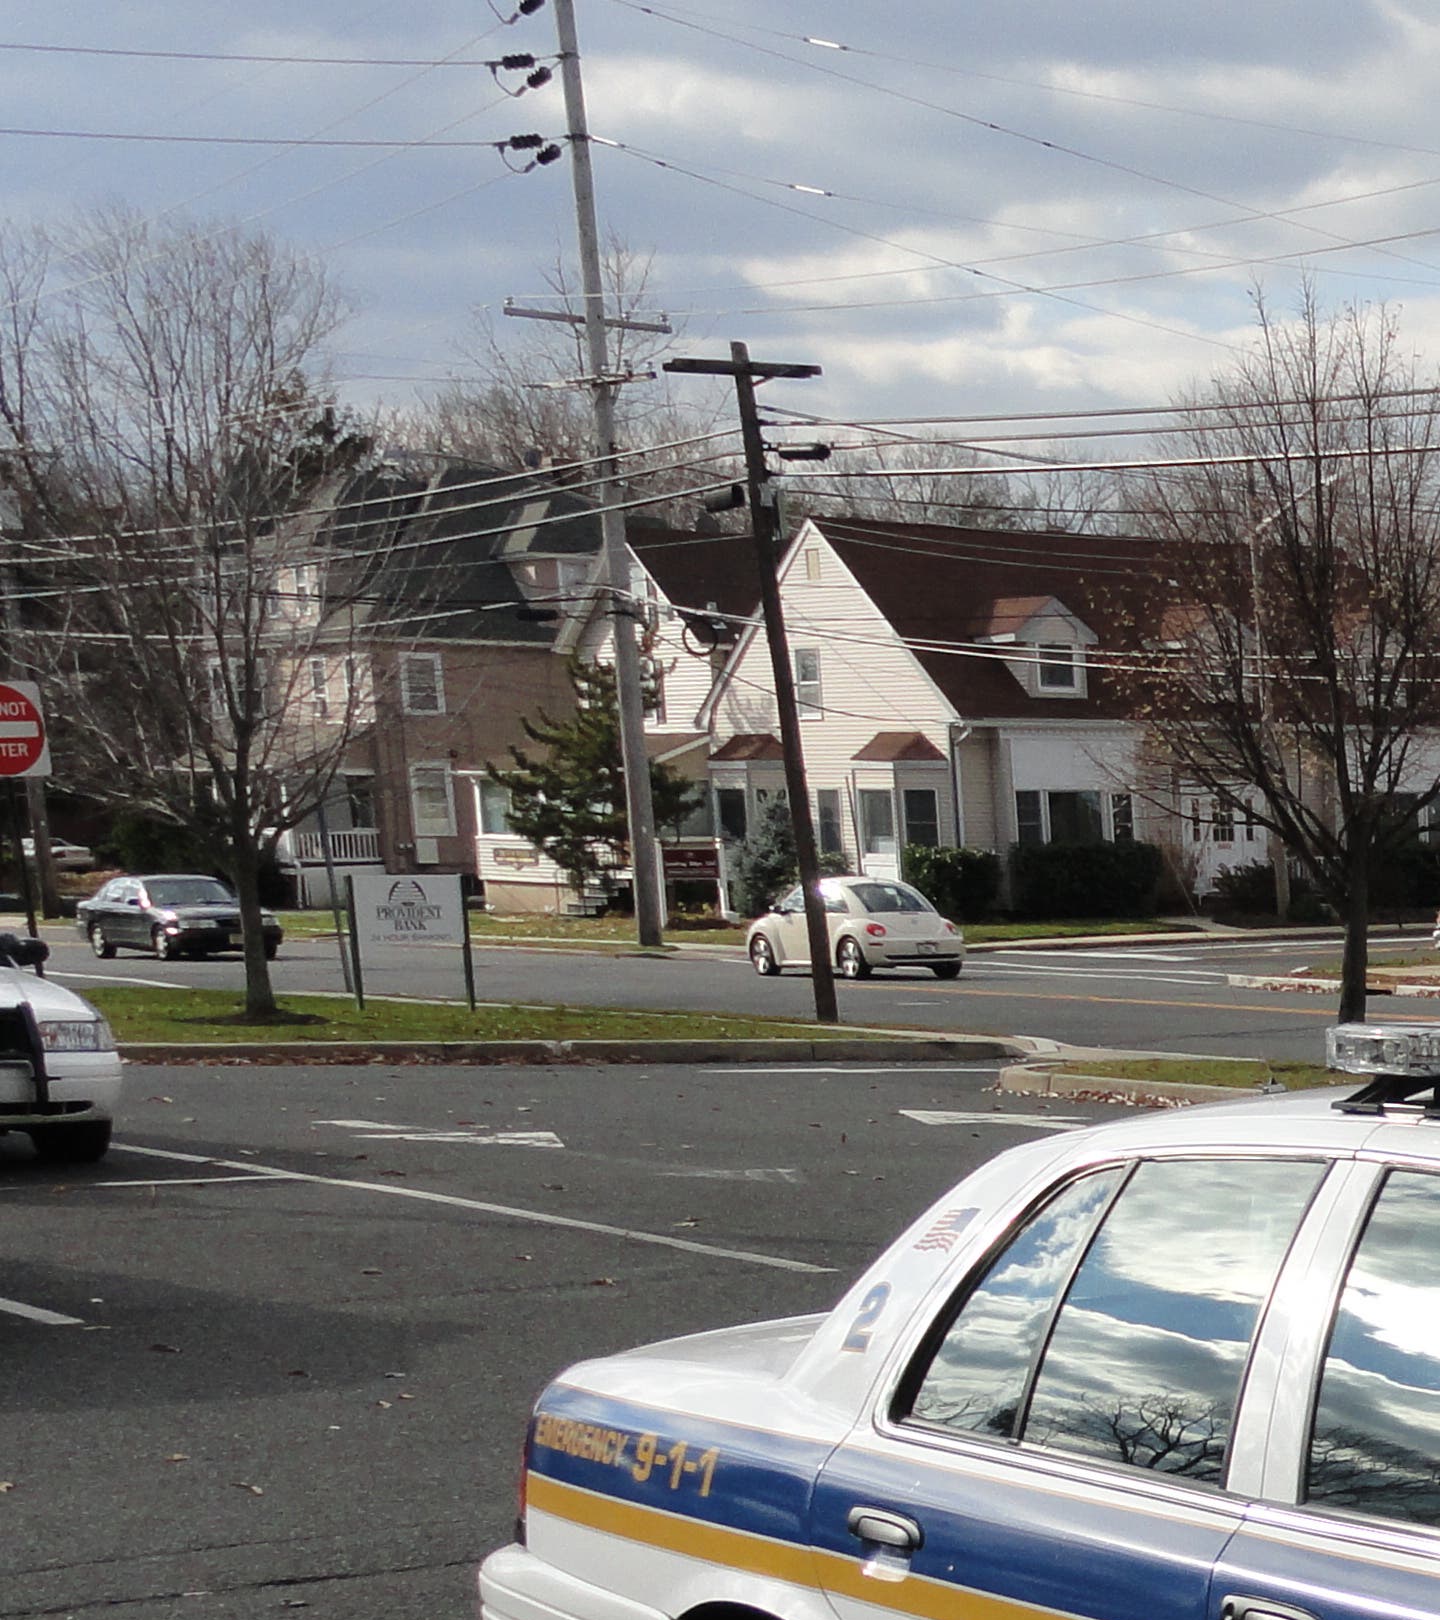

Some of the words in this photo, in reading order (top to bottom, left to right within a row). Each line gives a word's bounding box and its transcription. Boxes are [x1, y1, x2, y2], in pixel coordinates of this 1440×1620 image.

[0, 702, 27, 716] NOT
[0, 743, 29, 757] TER
[376, 905, 442, 920] PROVIDENT
[394, 920, 428, 931] BANK
[840, 1281, 892, 1354] 2
[631, 1431, 721, 1498] 9-1-1
